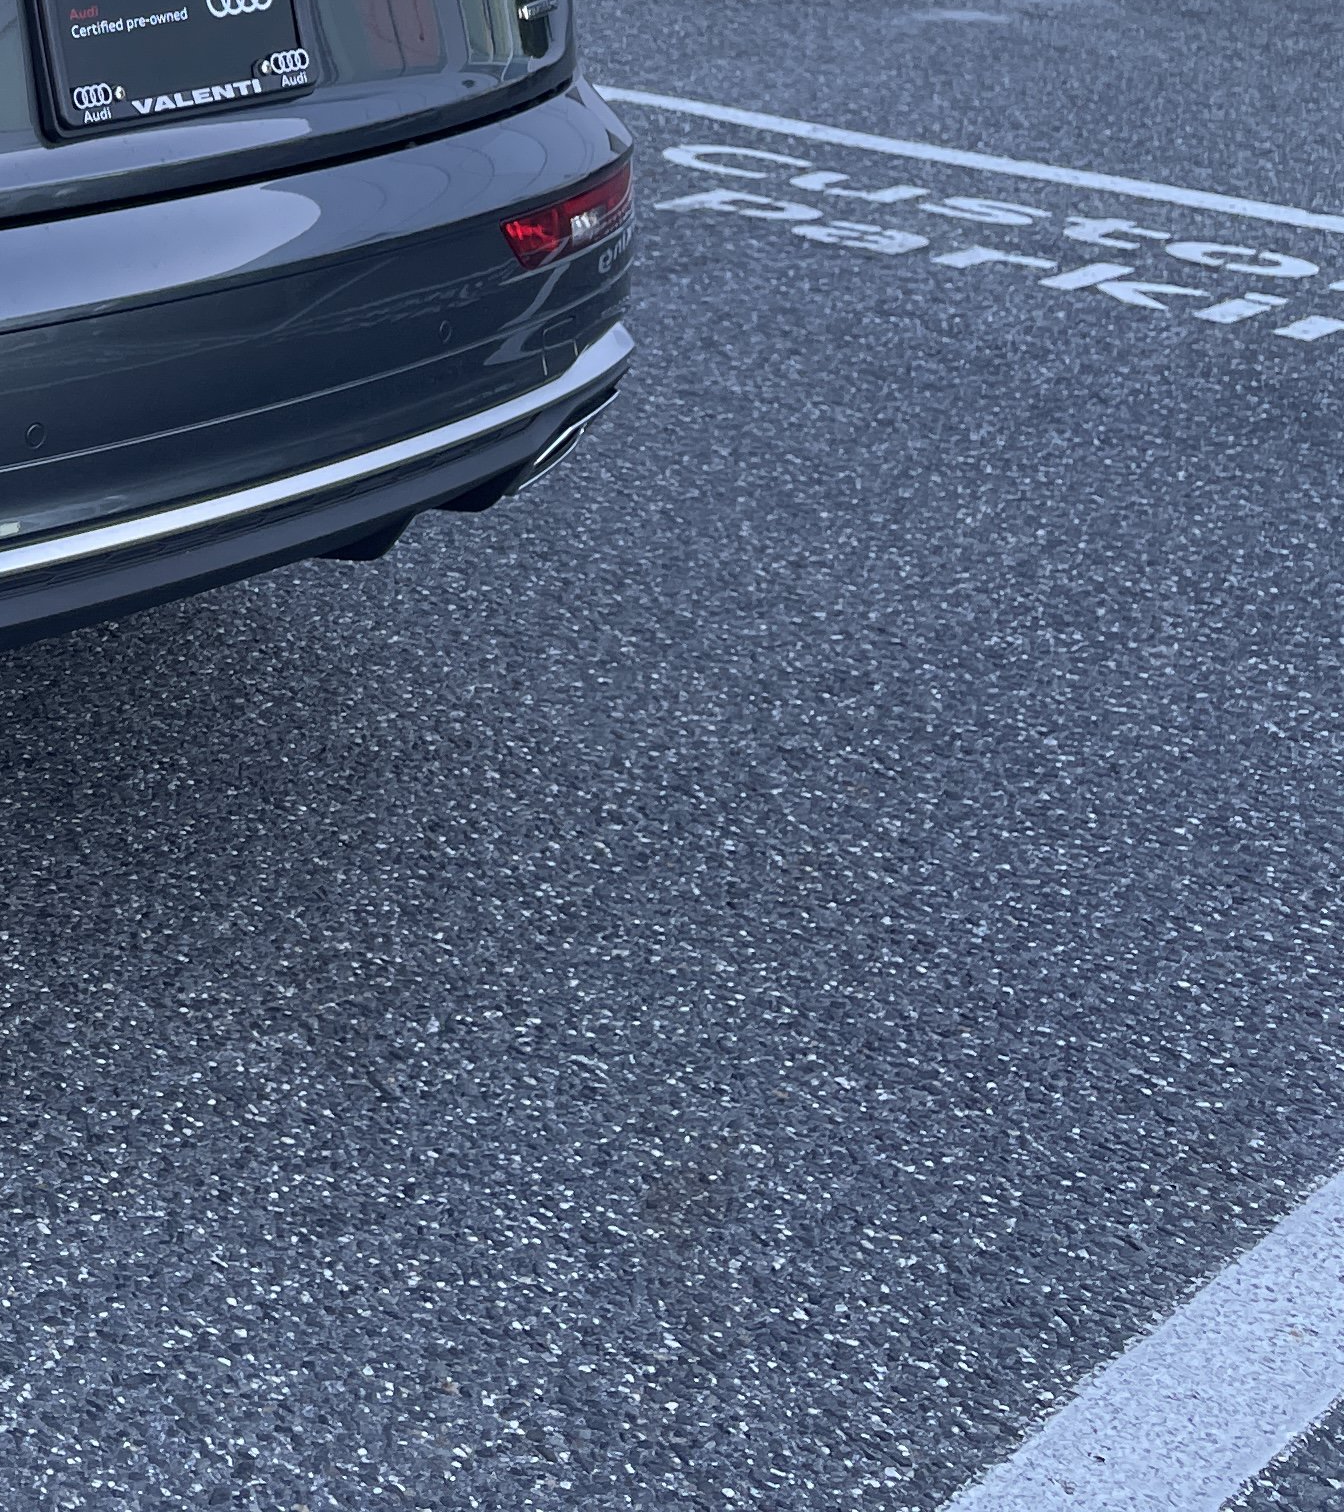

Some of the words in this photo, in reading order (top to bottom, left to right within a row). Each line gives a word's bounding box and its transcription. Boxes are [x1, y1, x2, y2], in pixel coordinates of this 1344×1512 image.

[69, 5, 100, 21] Audi
[70, 18, 124, 39] Certified
[126, 6, 189, 33] pre-owned
[280, 72, 308, 89] Audi
[132, 78, 263, 116] VALENTI
[83, 107, 112, 124] Audi
[662, 144, 1344, 292] Custo
